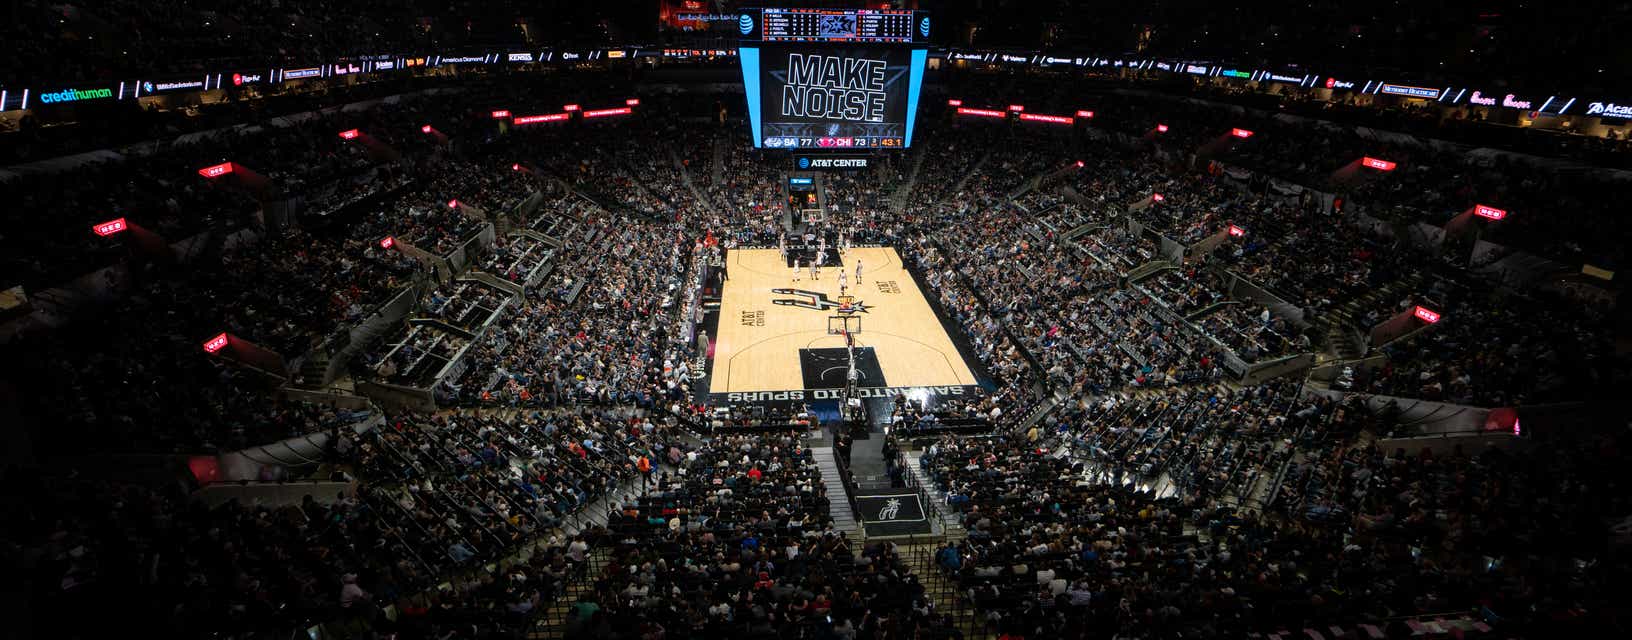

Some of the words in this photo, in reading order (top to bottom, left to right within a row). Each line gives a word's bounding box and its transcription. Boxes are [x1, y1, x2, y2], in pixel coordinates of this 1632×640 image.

[787, 53, 887, 92] MAKE
[40, 88, 112, 104] credithuman
[782, 84, 886, 122] NOISE
[784, 138, 796, 146] SA
[801, 138, 812, 146] 77
[836, 138, 850, 147] CHI
[855, 138, 866, 147] 73
[881, 138, 902, 146] 43.1
[811, 159, 833, 168] AT&T
[834, 159, 868, 168] CENTER
[742, 311, 755, 327] AT&T
[756, 310, 765, 327] CENTER
[727, 391, 805, 402] SPURS
